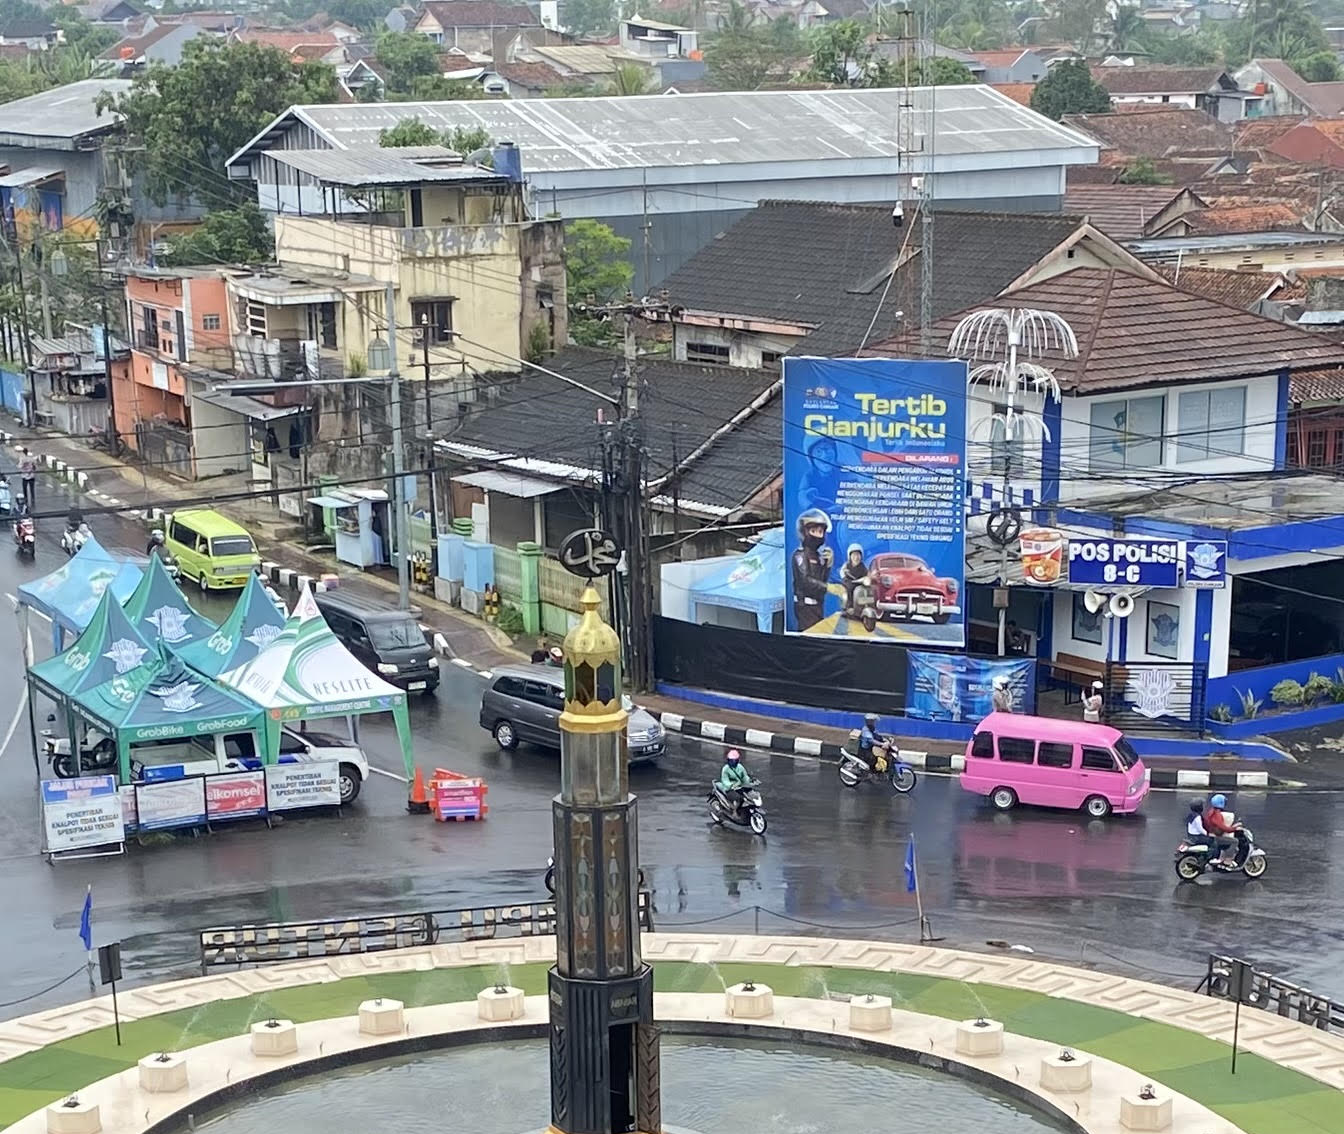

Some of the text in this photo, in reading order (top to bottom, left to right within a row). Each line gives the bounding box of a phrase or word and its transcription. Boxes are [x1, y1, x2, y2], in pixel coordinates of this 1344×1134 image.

[854, 393, 947, 416] Tertib
[804, 414, 946, 442] Cianjurku
[1069, 542, 1177, 563] POS POLISI
[207, 631, 233, 655] Grab
[64, 646, 91, 671] Grab
[312, 677, 374, 696] NESLITE
[136, 716, 248, 738] GrabBike GrabFood
[207, 783, 263, 802] elkomsel
